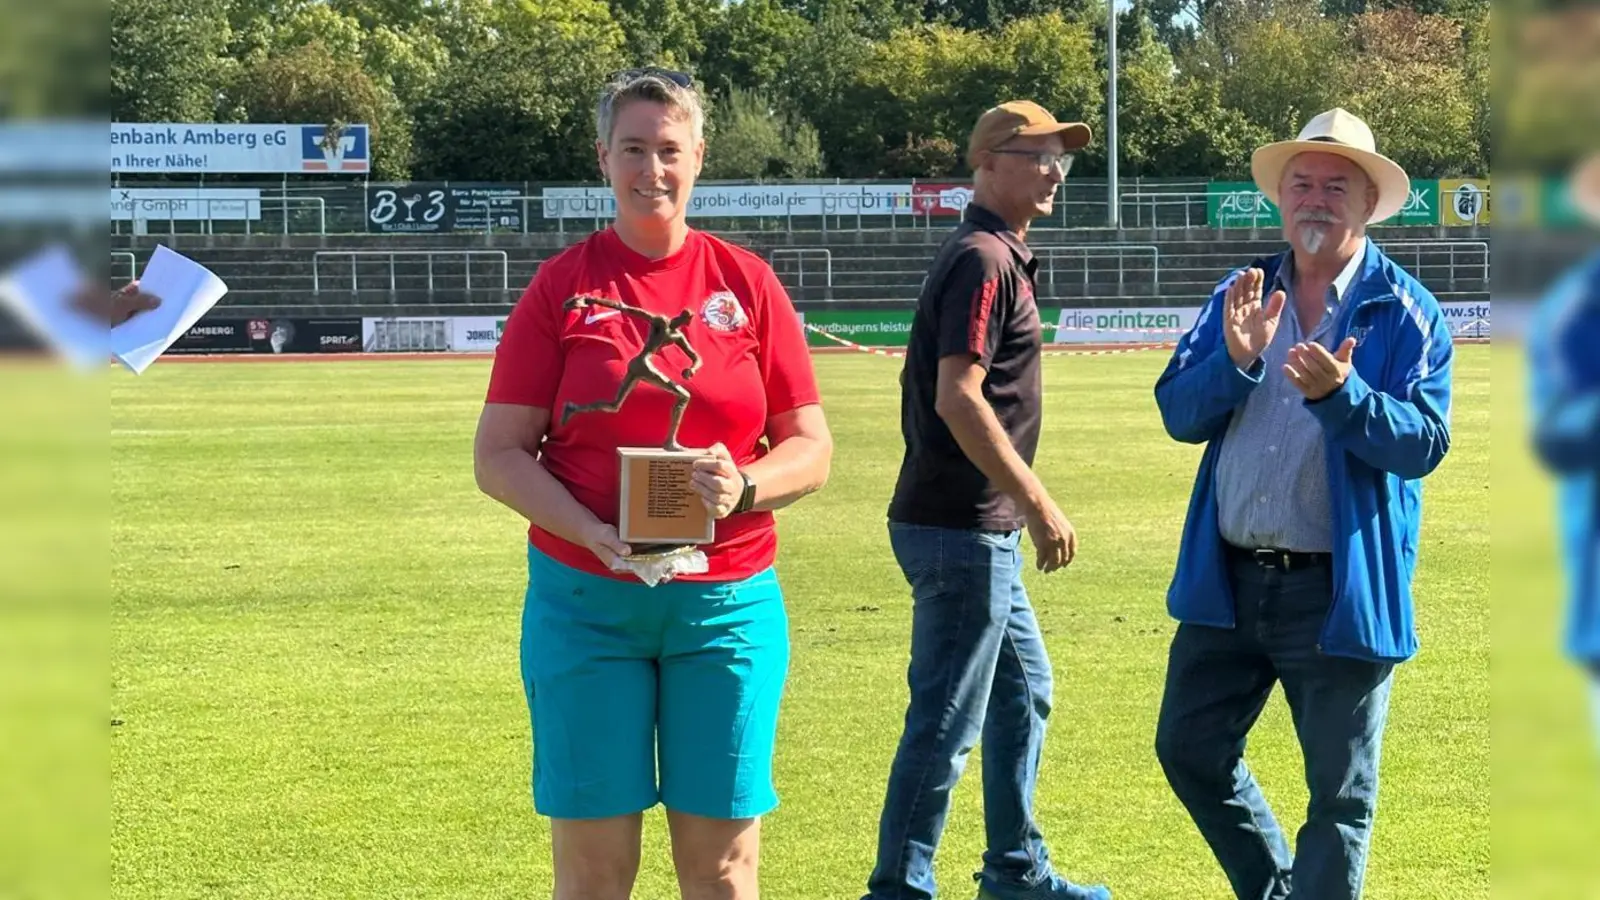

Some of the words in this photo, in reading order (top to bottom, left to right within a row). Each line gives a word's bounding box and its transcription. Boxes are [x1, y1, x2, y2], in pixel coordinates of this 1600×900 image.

[111, 128, 177, 144] enbank
[183, 128, 257, 149] Amberg
[263, 130, 286, 146] eG
[126, 154, 161, 167] Ihrer
[165, 154, 208, 167] Nähe!
[141, 199, 188, 212] GmbH
[423, 190, 445, 222] 3
[545, 189, 604, 217] grobi
[823, 187, 880, 215] grobi
[1221, 190, 1272, 212] AOK
[190, 326, 235, 336] AMBERG!
[1066, 311, 1094, 328] die
[1096, 310, 1180, 333] printzen
